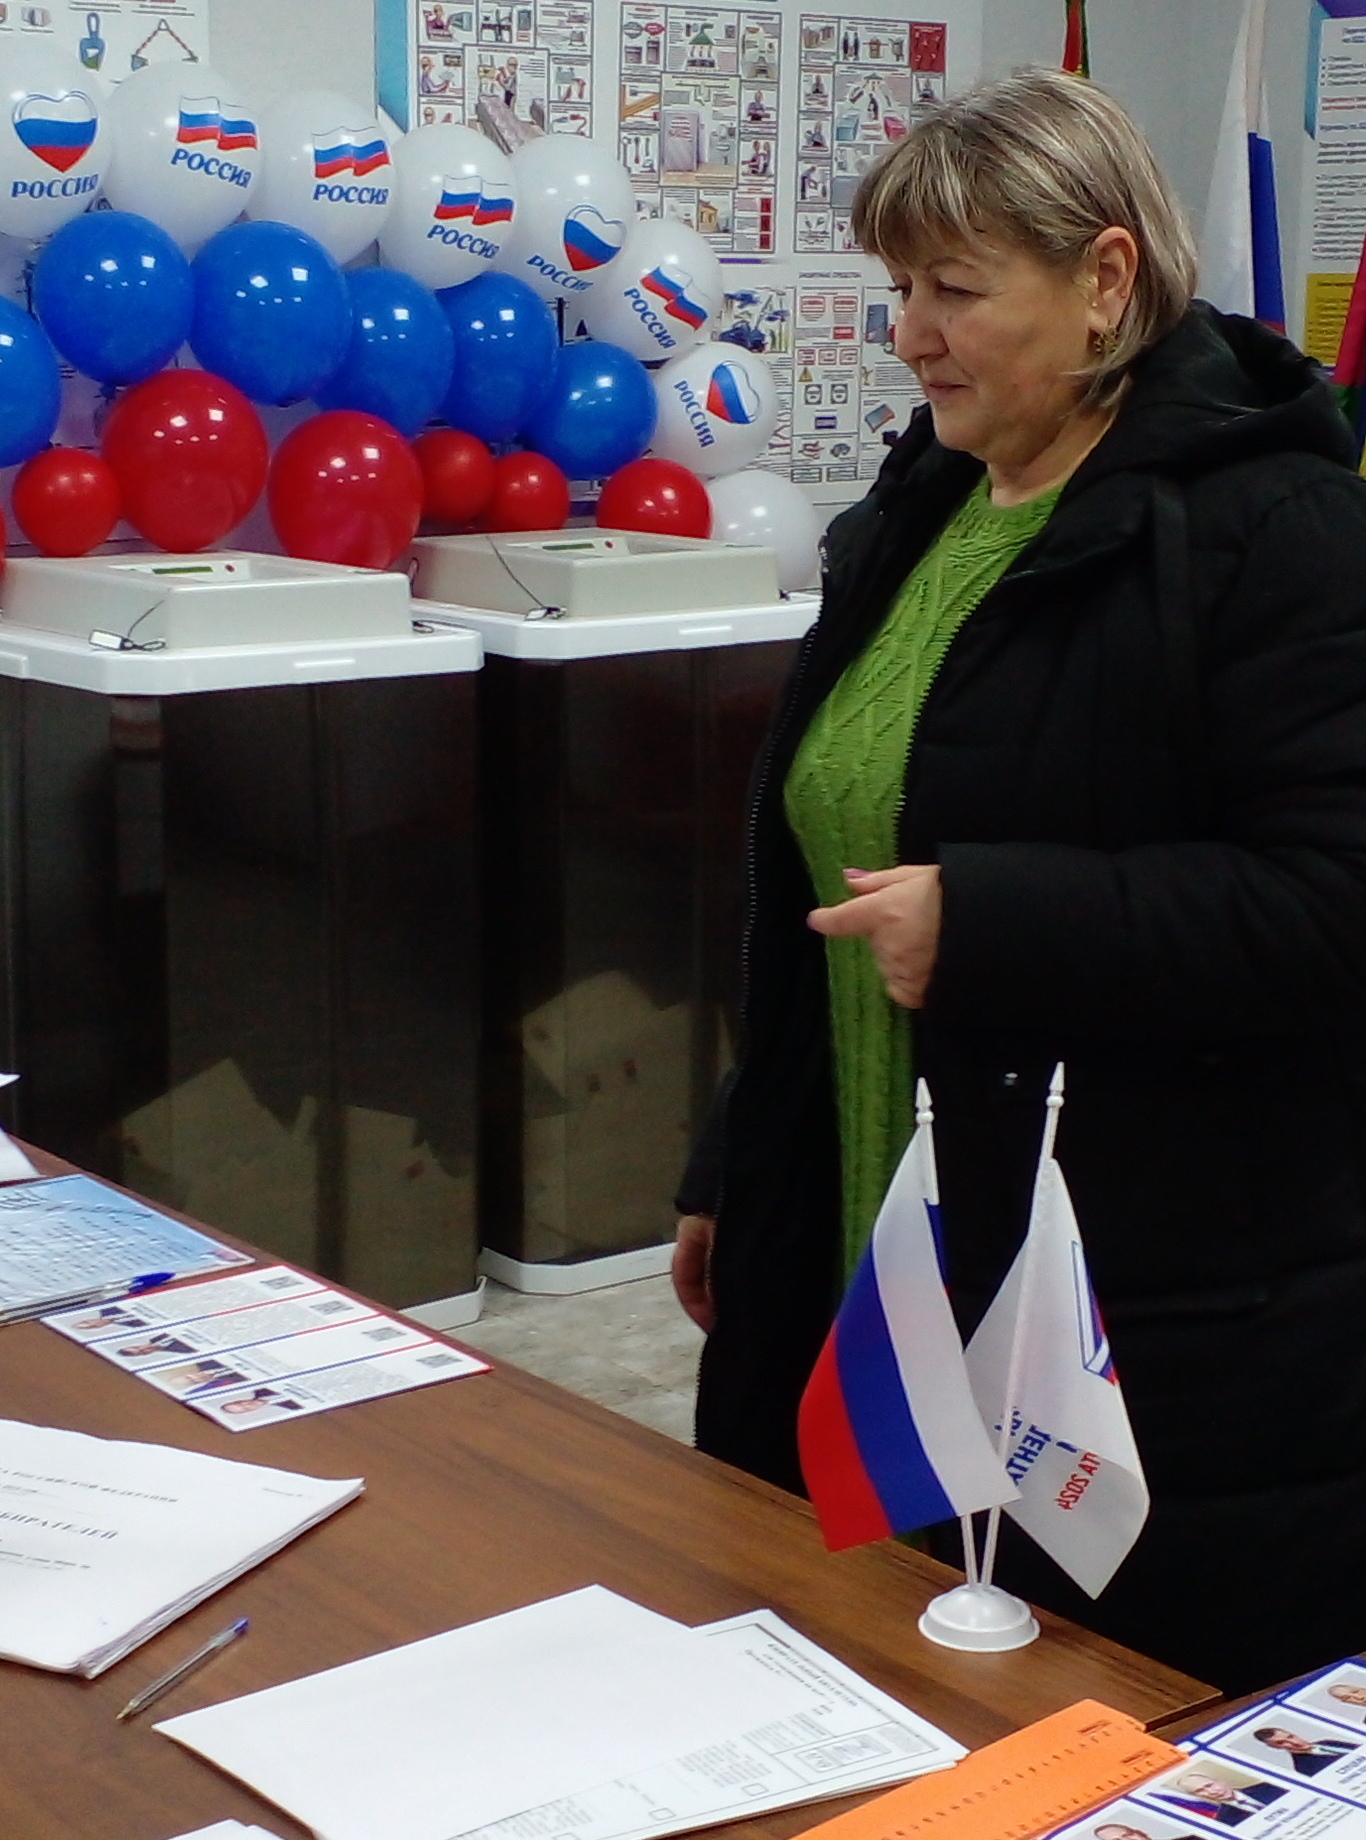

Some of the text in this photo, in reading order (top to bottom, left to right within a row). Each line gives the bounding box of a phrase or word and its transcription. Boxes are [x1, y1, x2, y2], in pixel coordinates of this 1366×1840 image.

[11, 173, 100, 199] РОССИЯ
[171, 148, 251, 189] РОССИЯ
[313, 183, 389, 206] РОССИЯ
[623, 287, 677, 349] РОССИЯ
[673, 380, 716, 448] РОССИЯ
